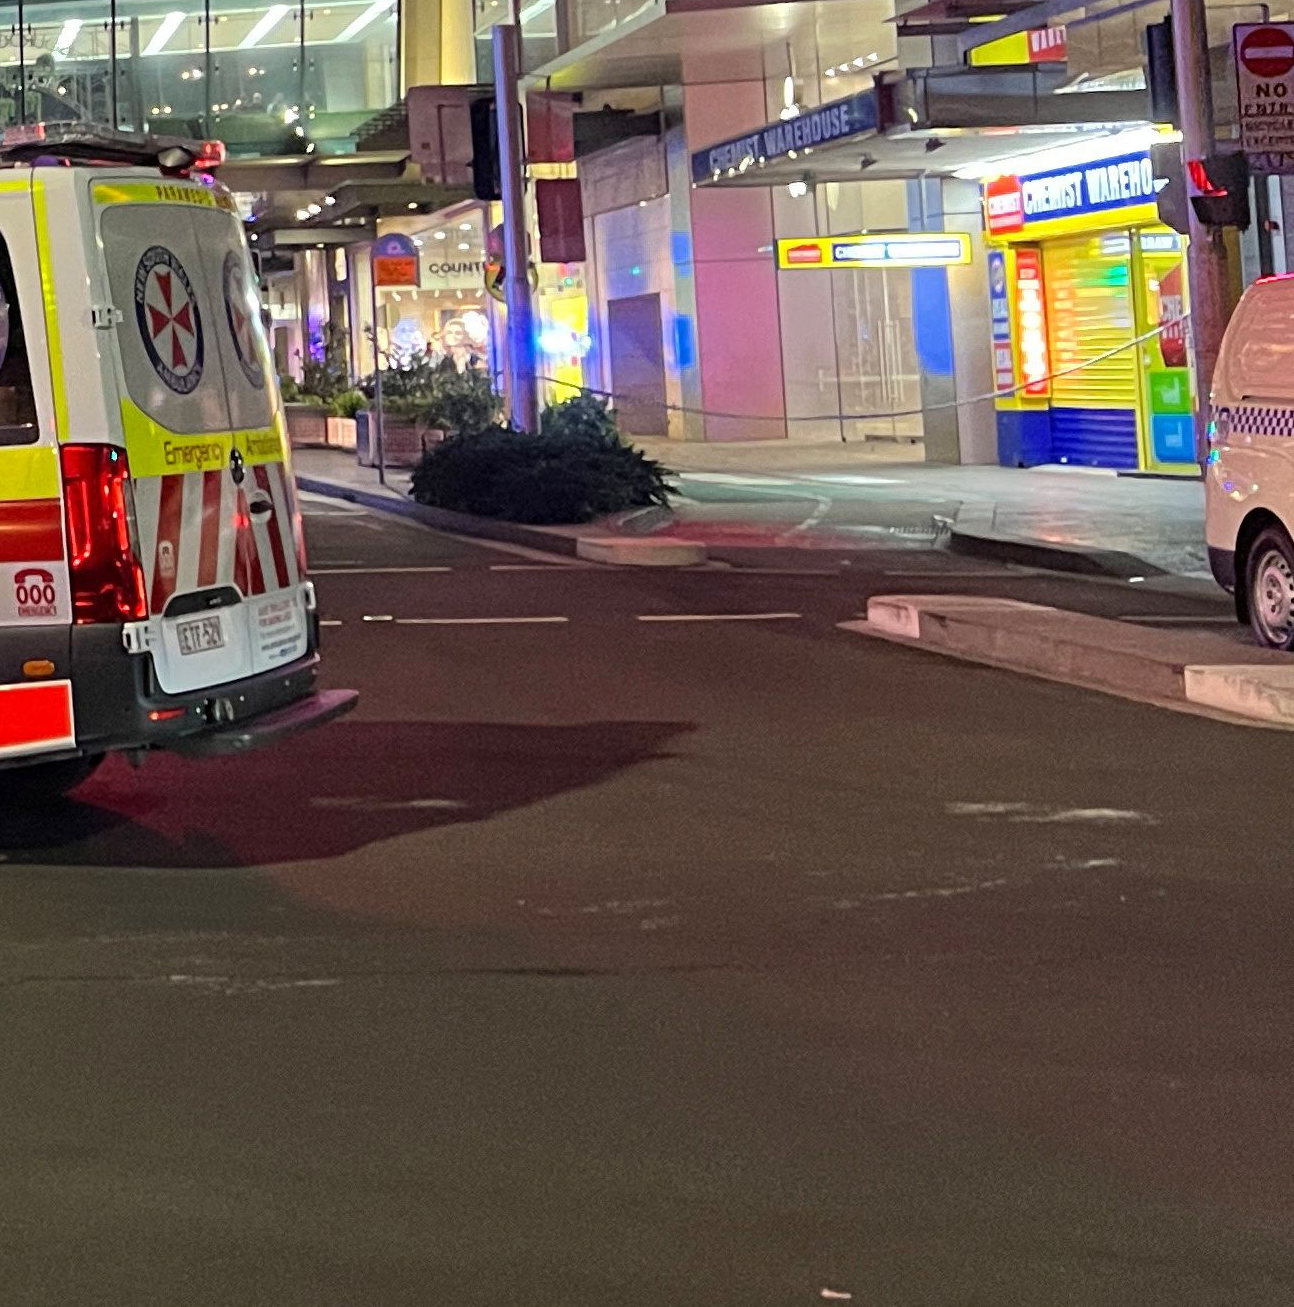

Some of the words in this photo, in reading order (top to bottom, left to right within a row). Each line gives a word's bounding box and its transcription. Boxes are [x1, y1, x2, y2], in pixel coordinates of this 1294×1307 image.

[1255, 82, 1288, 98] NO
[763, 104, 850, 156] WAREHOUSE
[1022, 171, 1083, 215] CHEMIST
[1085, 157, 1154, 205] WAREHO
[15, 584, 56, 605] 000
